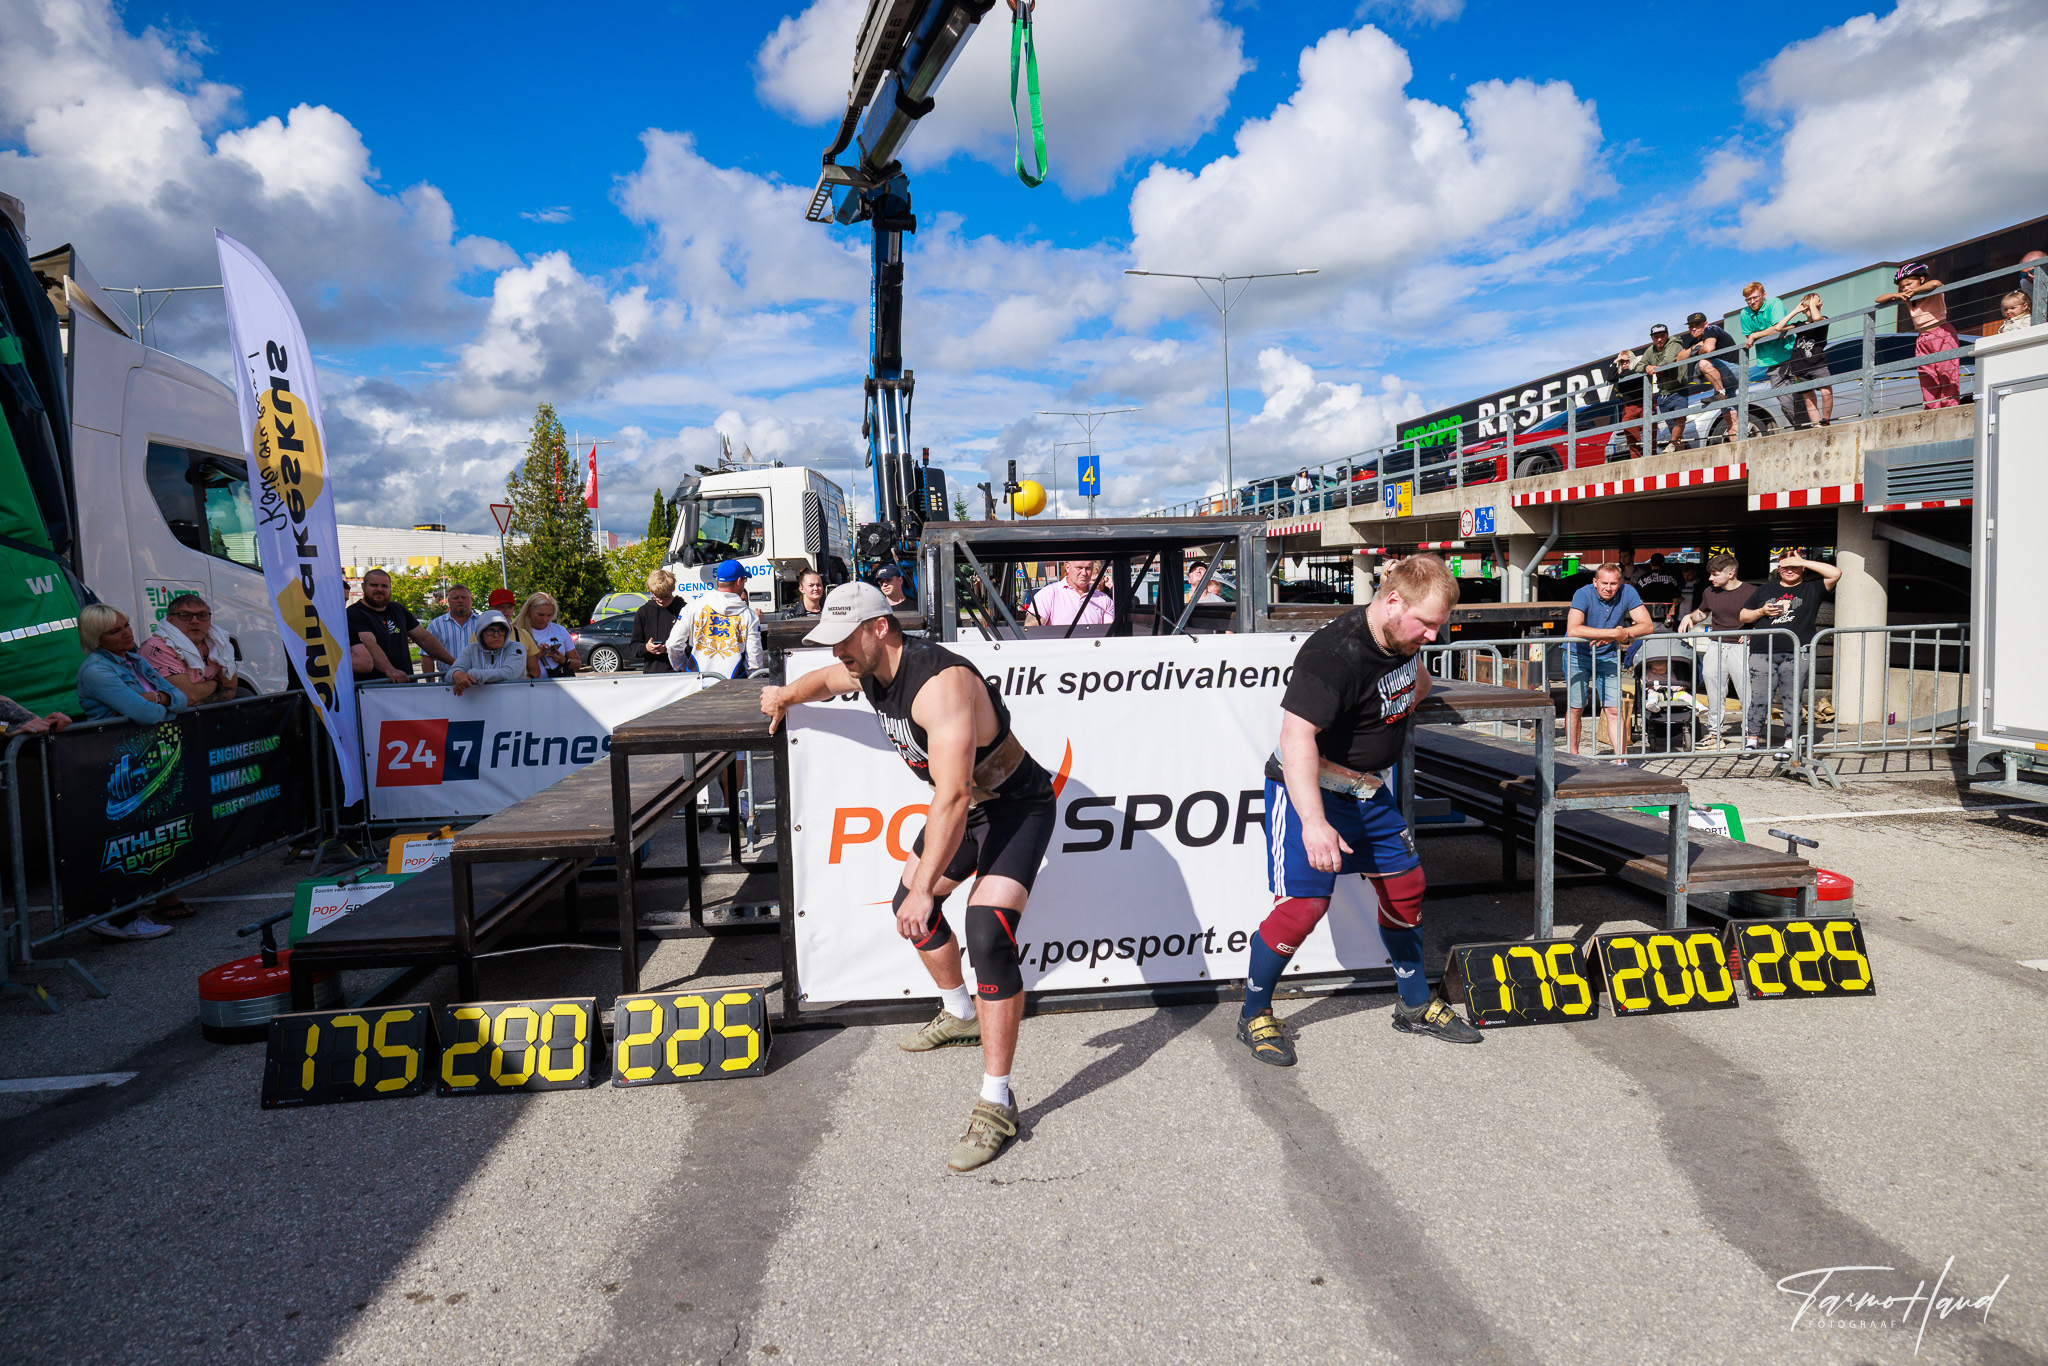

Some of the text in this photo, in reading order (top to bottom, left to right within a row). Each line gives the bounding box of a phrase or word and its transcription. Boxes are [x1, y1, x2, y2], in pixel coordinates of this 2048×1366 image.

[1478, 368, 1616, 438] RESERV
[1082, 465, 1096, 486] 4
[678, 582, 714, 592] GENNO
[985, 666, 1046, 696] alik
[208, 735, 281, 766] ENGINEERING
[385, 739, 437, 770] 24
[452, 740, 473, 767] 7
[210, 764, 262, 794] HUMAN
[105, 818, 188, 865] ATHLETE
[828, 790, 1266, 865] PO SPOR
[126, 843, 172, 870] BYTES
[404, 857, 426, 866] POP
[312, 906, 338, 916] POP
[1610, 933, 1734, 1009] 200
[1746, 921, 1872, 994] 225
[1492, 943, 1593, 1016] 175
[302, 1009, 419, 1093] 175
[441, 1003, 587, 1088] 200
[618, 992, 760, 1080] 225
